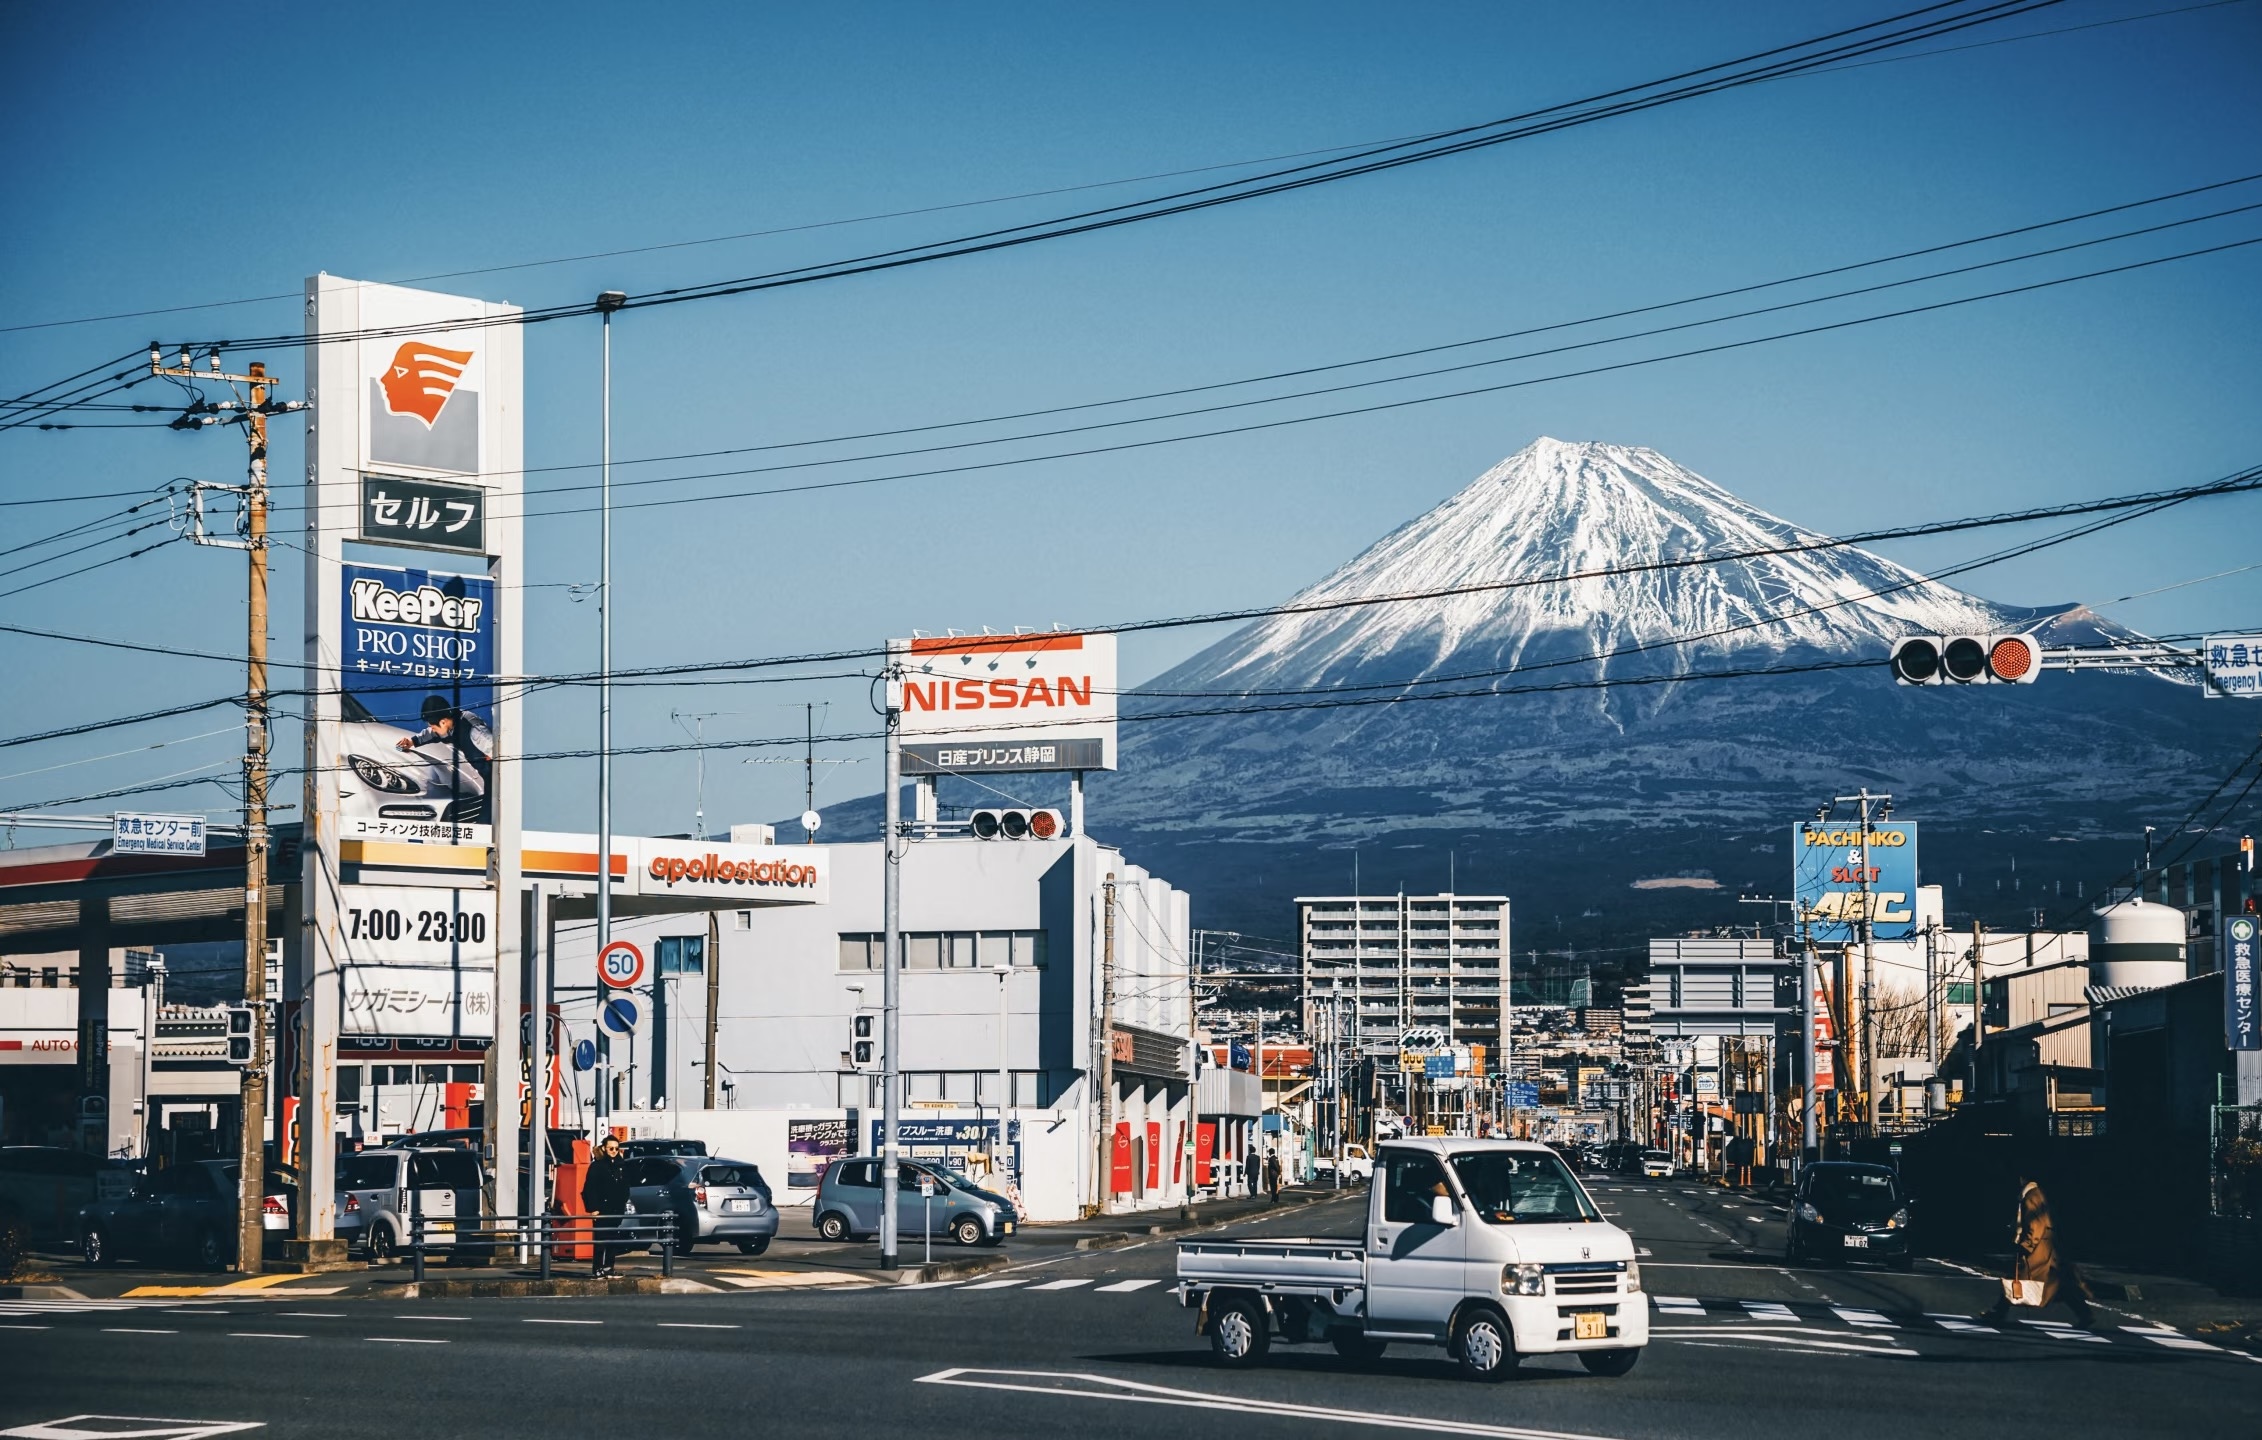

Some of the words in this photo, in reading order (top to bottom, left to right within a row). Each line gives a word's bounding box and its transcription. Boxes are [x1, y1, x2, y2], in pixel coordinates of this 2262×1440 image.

[370, 491, 475, 533] セルフ
[350, 578, 482, 632] KeePer
[356, 628, 407, 656] PRO
[412, 633, 476, 662] SHOP
[356, 658, 475, 680] キーパープロショップ
[2210, 672, 2256, 692] Emergency
[903, 675, 1091, 712] NISSAN
[938, 746, 1056, 766] 日産プリンス静岡
[118, 817, 202, 838] 救急センター前
[357, 821, 474, 840] コーティング技術認定店
[117, 836, 145, 850] Emergency
[146, 837, 166, 849] Medical
[166, 838, 185, 850] Service
[185, 839, 202, 851] Center
[1804, 831, 1906, 847] PACHINKO
[651, 853, 817, 884] apollostation
[349, 908, 401, 941] 7:00
[417, 910, 486, 944] 23:00
[607, 954, 634, 975] 50
[2234, 942, 2252, 1047] 救急医療センター
[31, 1040, 71, 1051] AUTO
